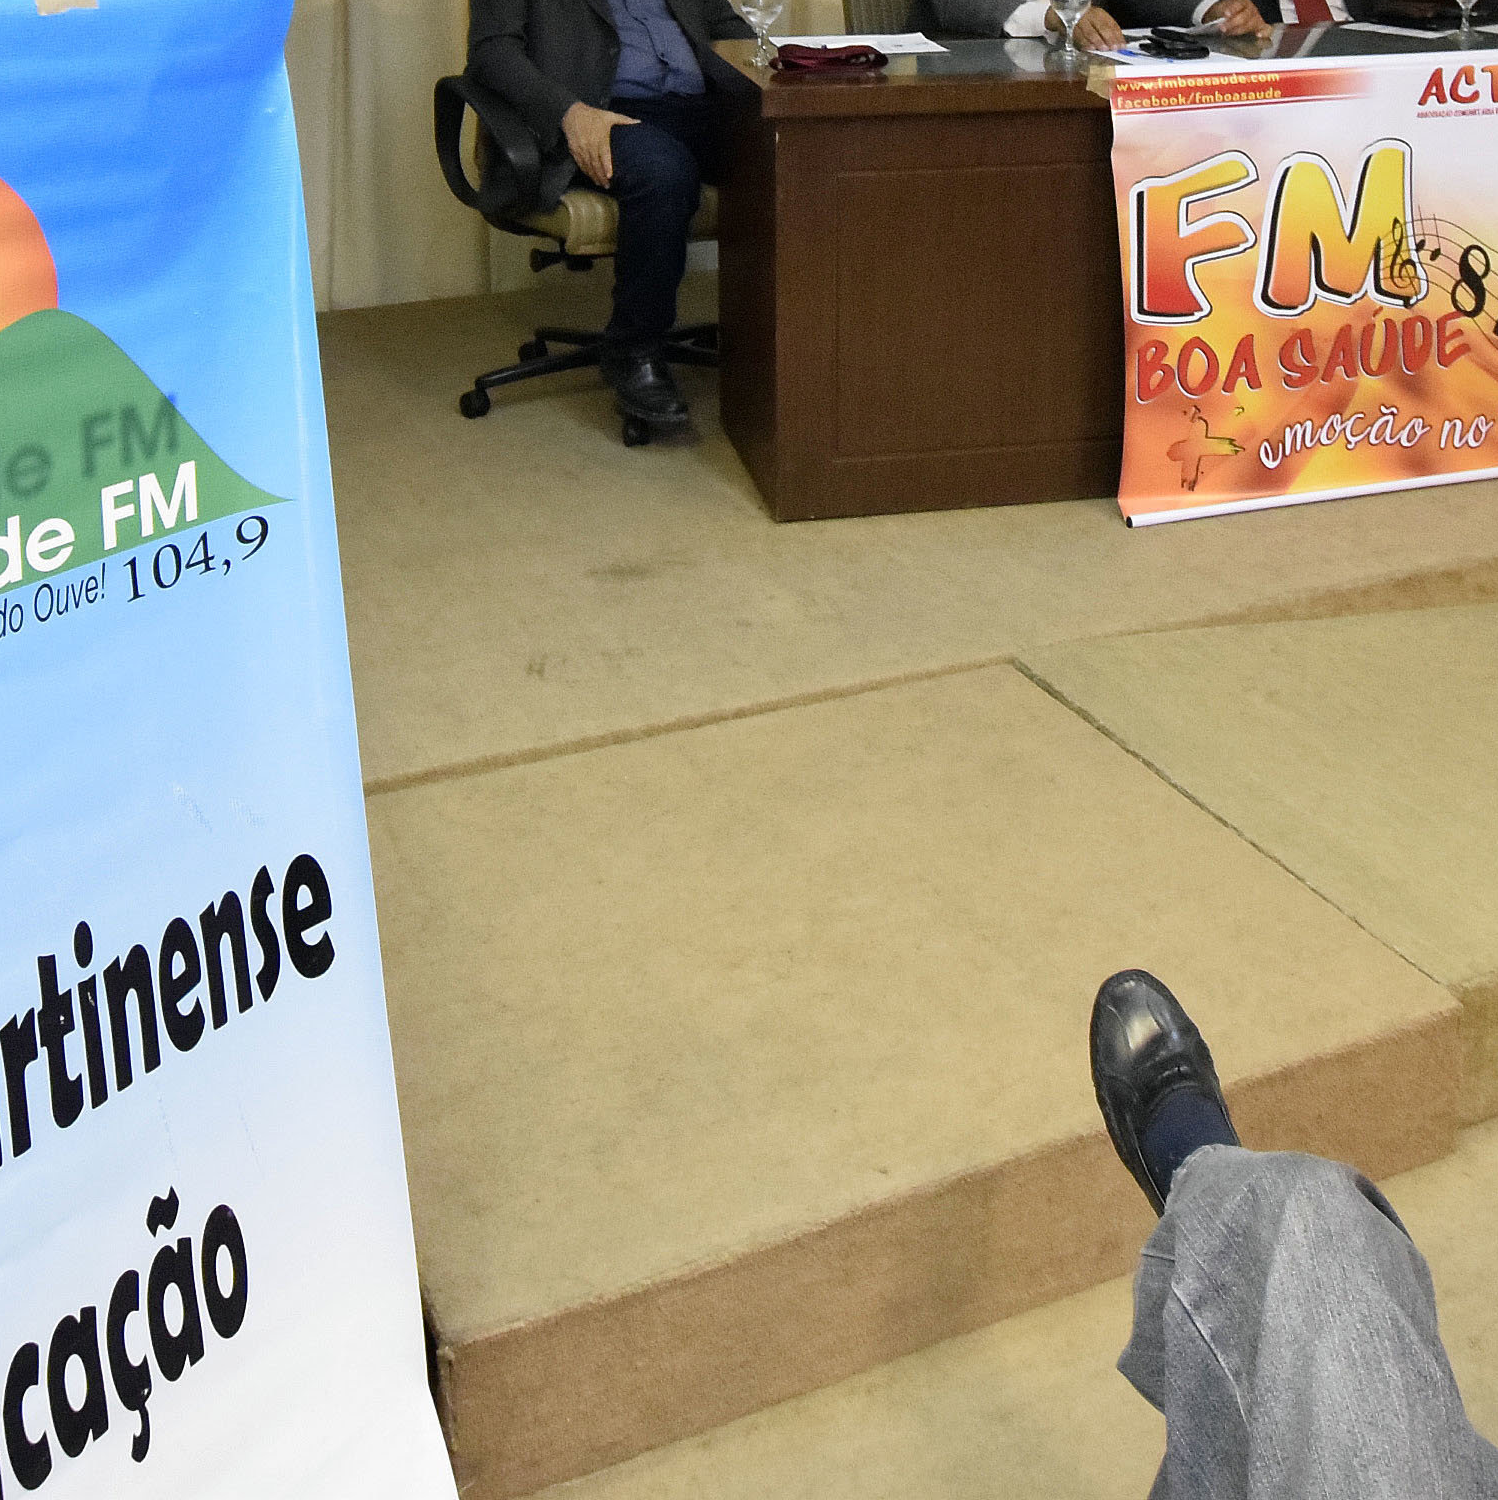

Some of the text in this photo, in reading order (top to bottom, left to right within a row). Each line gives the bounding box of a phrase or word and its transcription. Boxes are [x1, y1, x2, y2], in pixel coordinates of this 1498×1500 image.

[1116, 73, 1280, 92] www.fmboasaude.com
[1117, 89, 1282, 109] facebook/fmboasaude
[1130, 138, 1428, 325] FM
[1137, 307, 1472, 404] BOA SAÚDE
[1259, 405, 1430, 470] emoção
[1440, 414, 1495, 449] no
[101, 460, 199, 551] FM
[34, 562, 107, 622] Ouve!
[123, 515, 269, 603] 104,9
